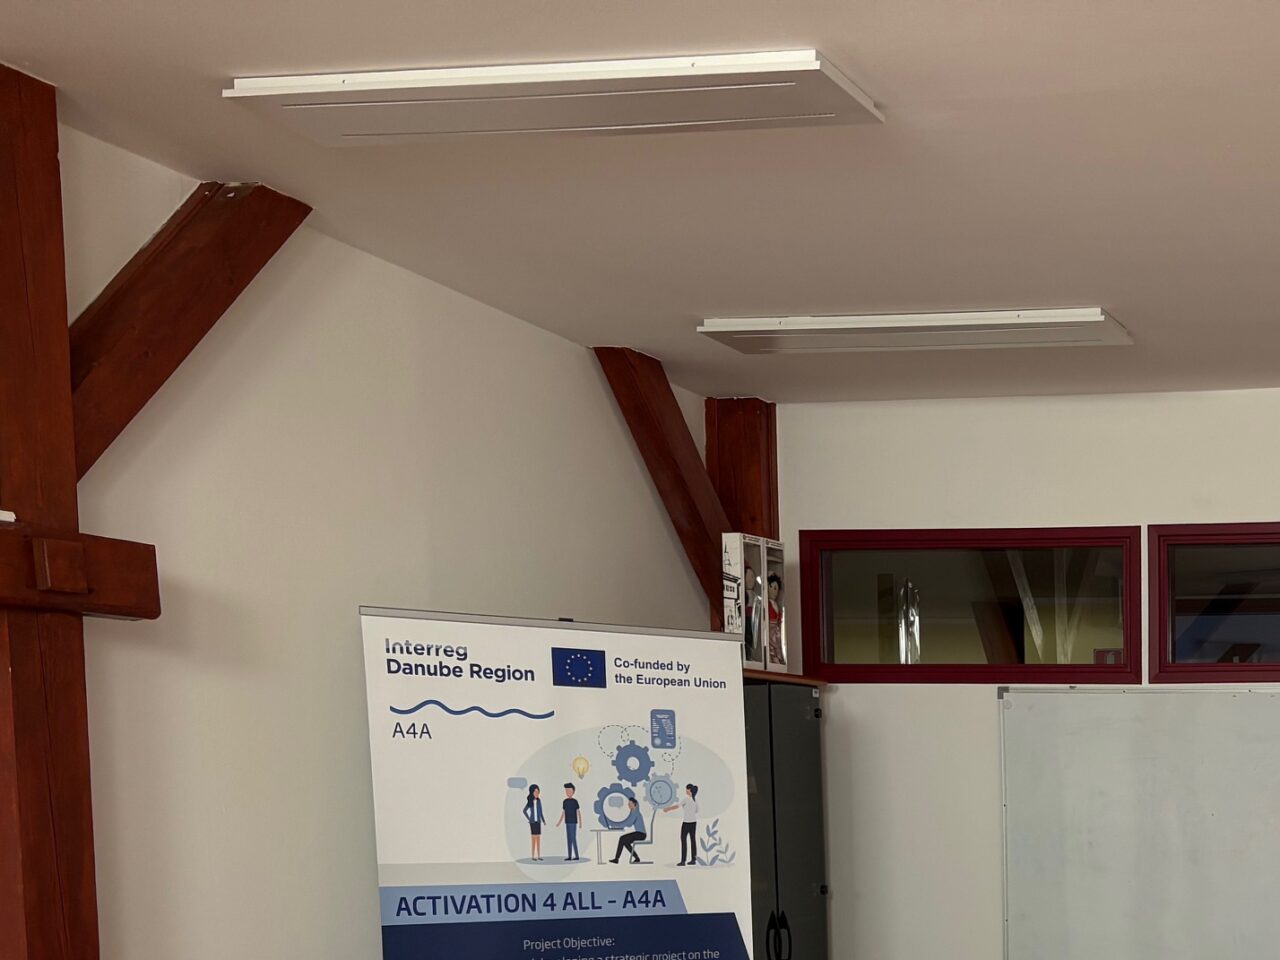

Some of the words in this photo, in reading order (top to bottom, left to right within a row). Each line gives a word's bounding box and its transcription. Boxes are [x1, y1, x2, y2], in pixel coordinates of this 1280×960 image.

[385, 638, 468, 661] Interreg
[386, 658, 463, 678] Danube
[469, 663, 535, 683] Region
[614, 657, 673, 671] Co-funded
[677, 661, 690, 674] by
[614, 673, 633, 684] the
[636, 674, 690, 688] European
[694, 677, 727, 689] Union
[392, 721, 432, 740] A4A
[396, 892, 537, 917] ACTIVATION
[542, 891, 557, 911] 4
[562, 891, 602, 911] ALL
[622, 889, 667, 909] A4A
[523, 939, 561, 952] Project
[563, 936, 615, 950] Objective:
[688, 951, 700, 960] on
[703, 949, 720, 959] the
